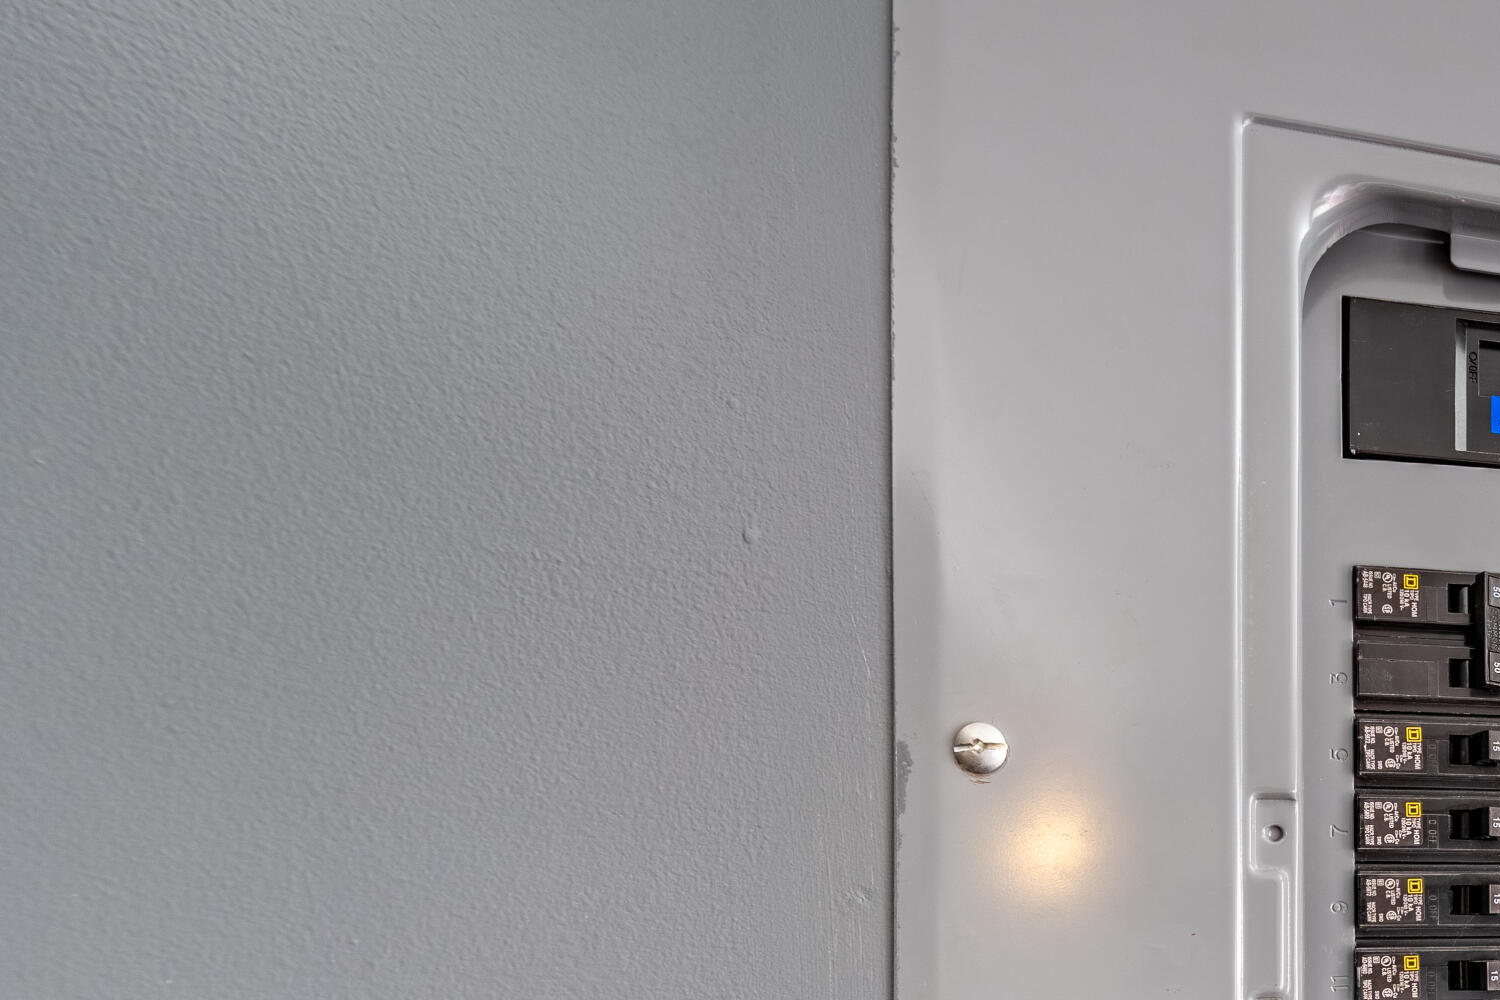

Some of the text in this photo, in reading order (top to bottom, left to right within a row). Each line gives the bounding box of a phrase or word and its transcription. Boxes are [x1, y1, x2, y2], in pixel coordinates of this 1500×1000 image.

[1492, 586, 1500, 598] 50
[1492, 741, 1500, 752] 15
[1492, 817, 1500, 828] 15
[1490, 970, 1498, 982] 15
